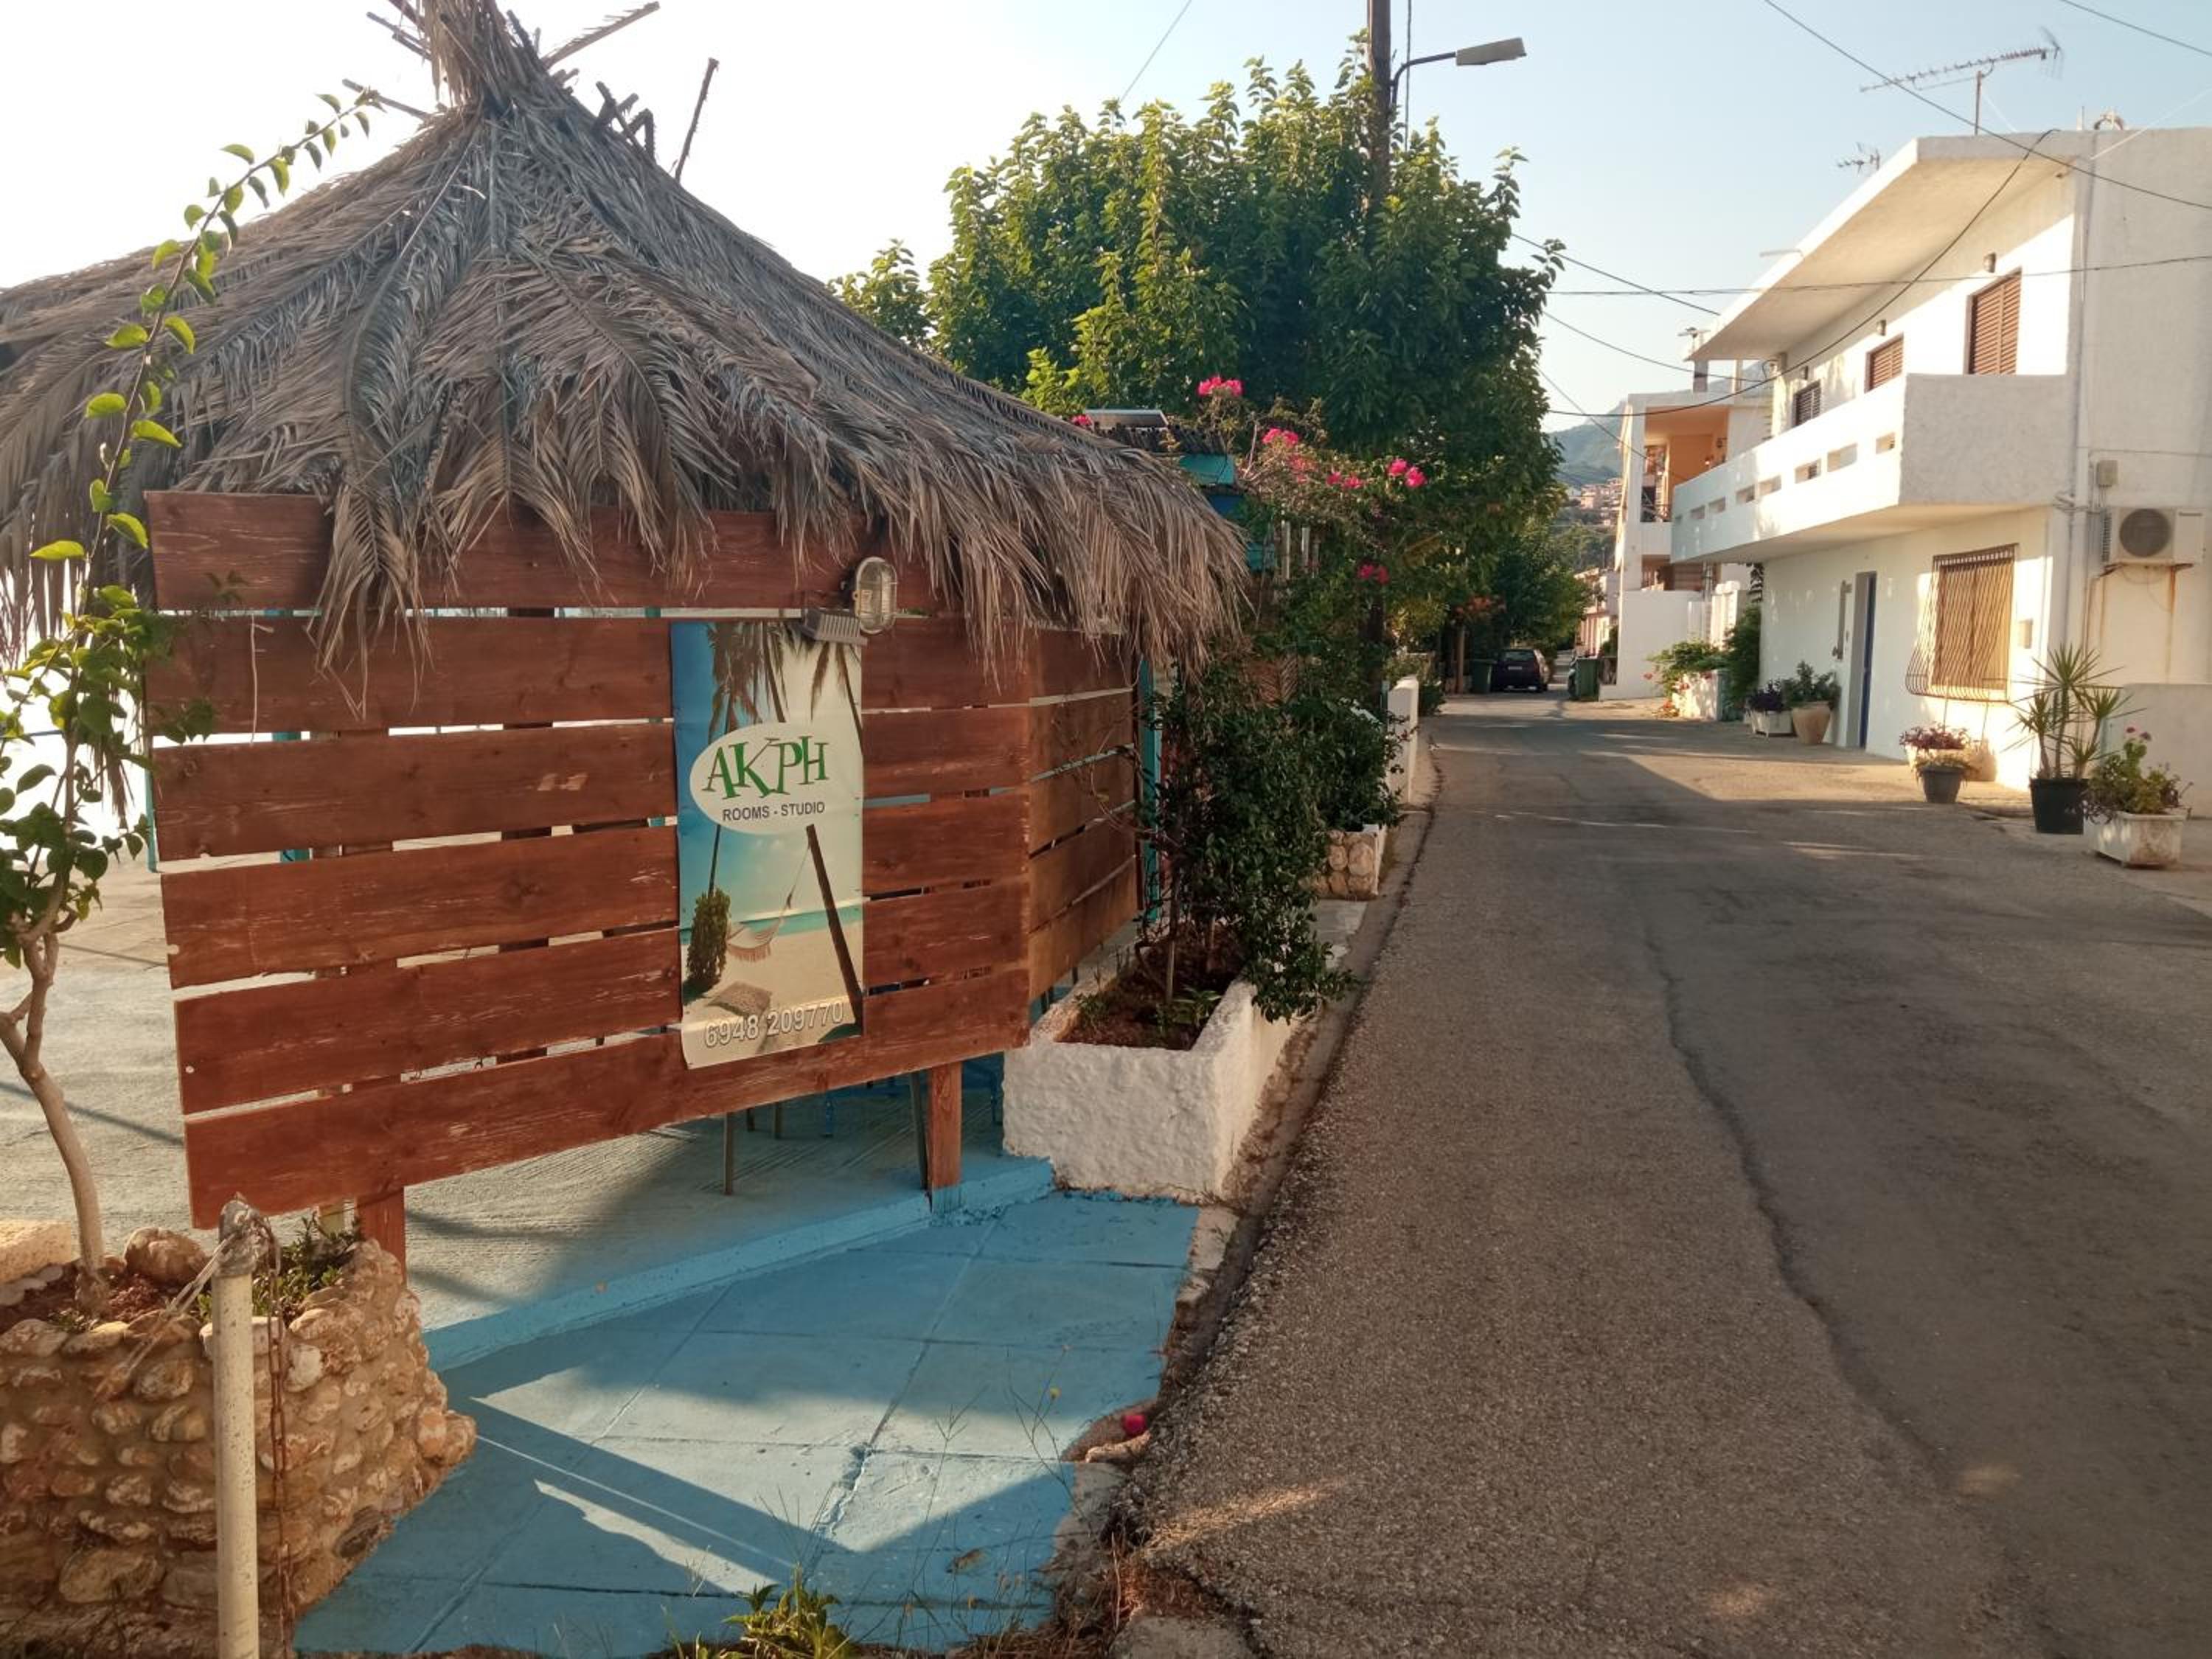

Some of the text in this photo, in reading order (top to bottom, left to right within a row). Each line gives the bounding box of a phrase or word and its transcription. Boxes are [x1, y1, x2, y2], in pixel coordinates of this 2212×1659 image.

[723, 806, 770, 821] ROOMS
[781, 802, 825, 816] STUDIO
[705, 1001, 844, 1048] 6948 209770
